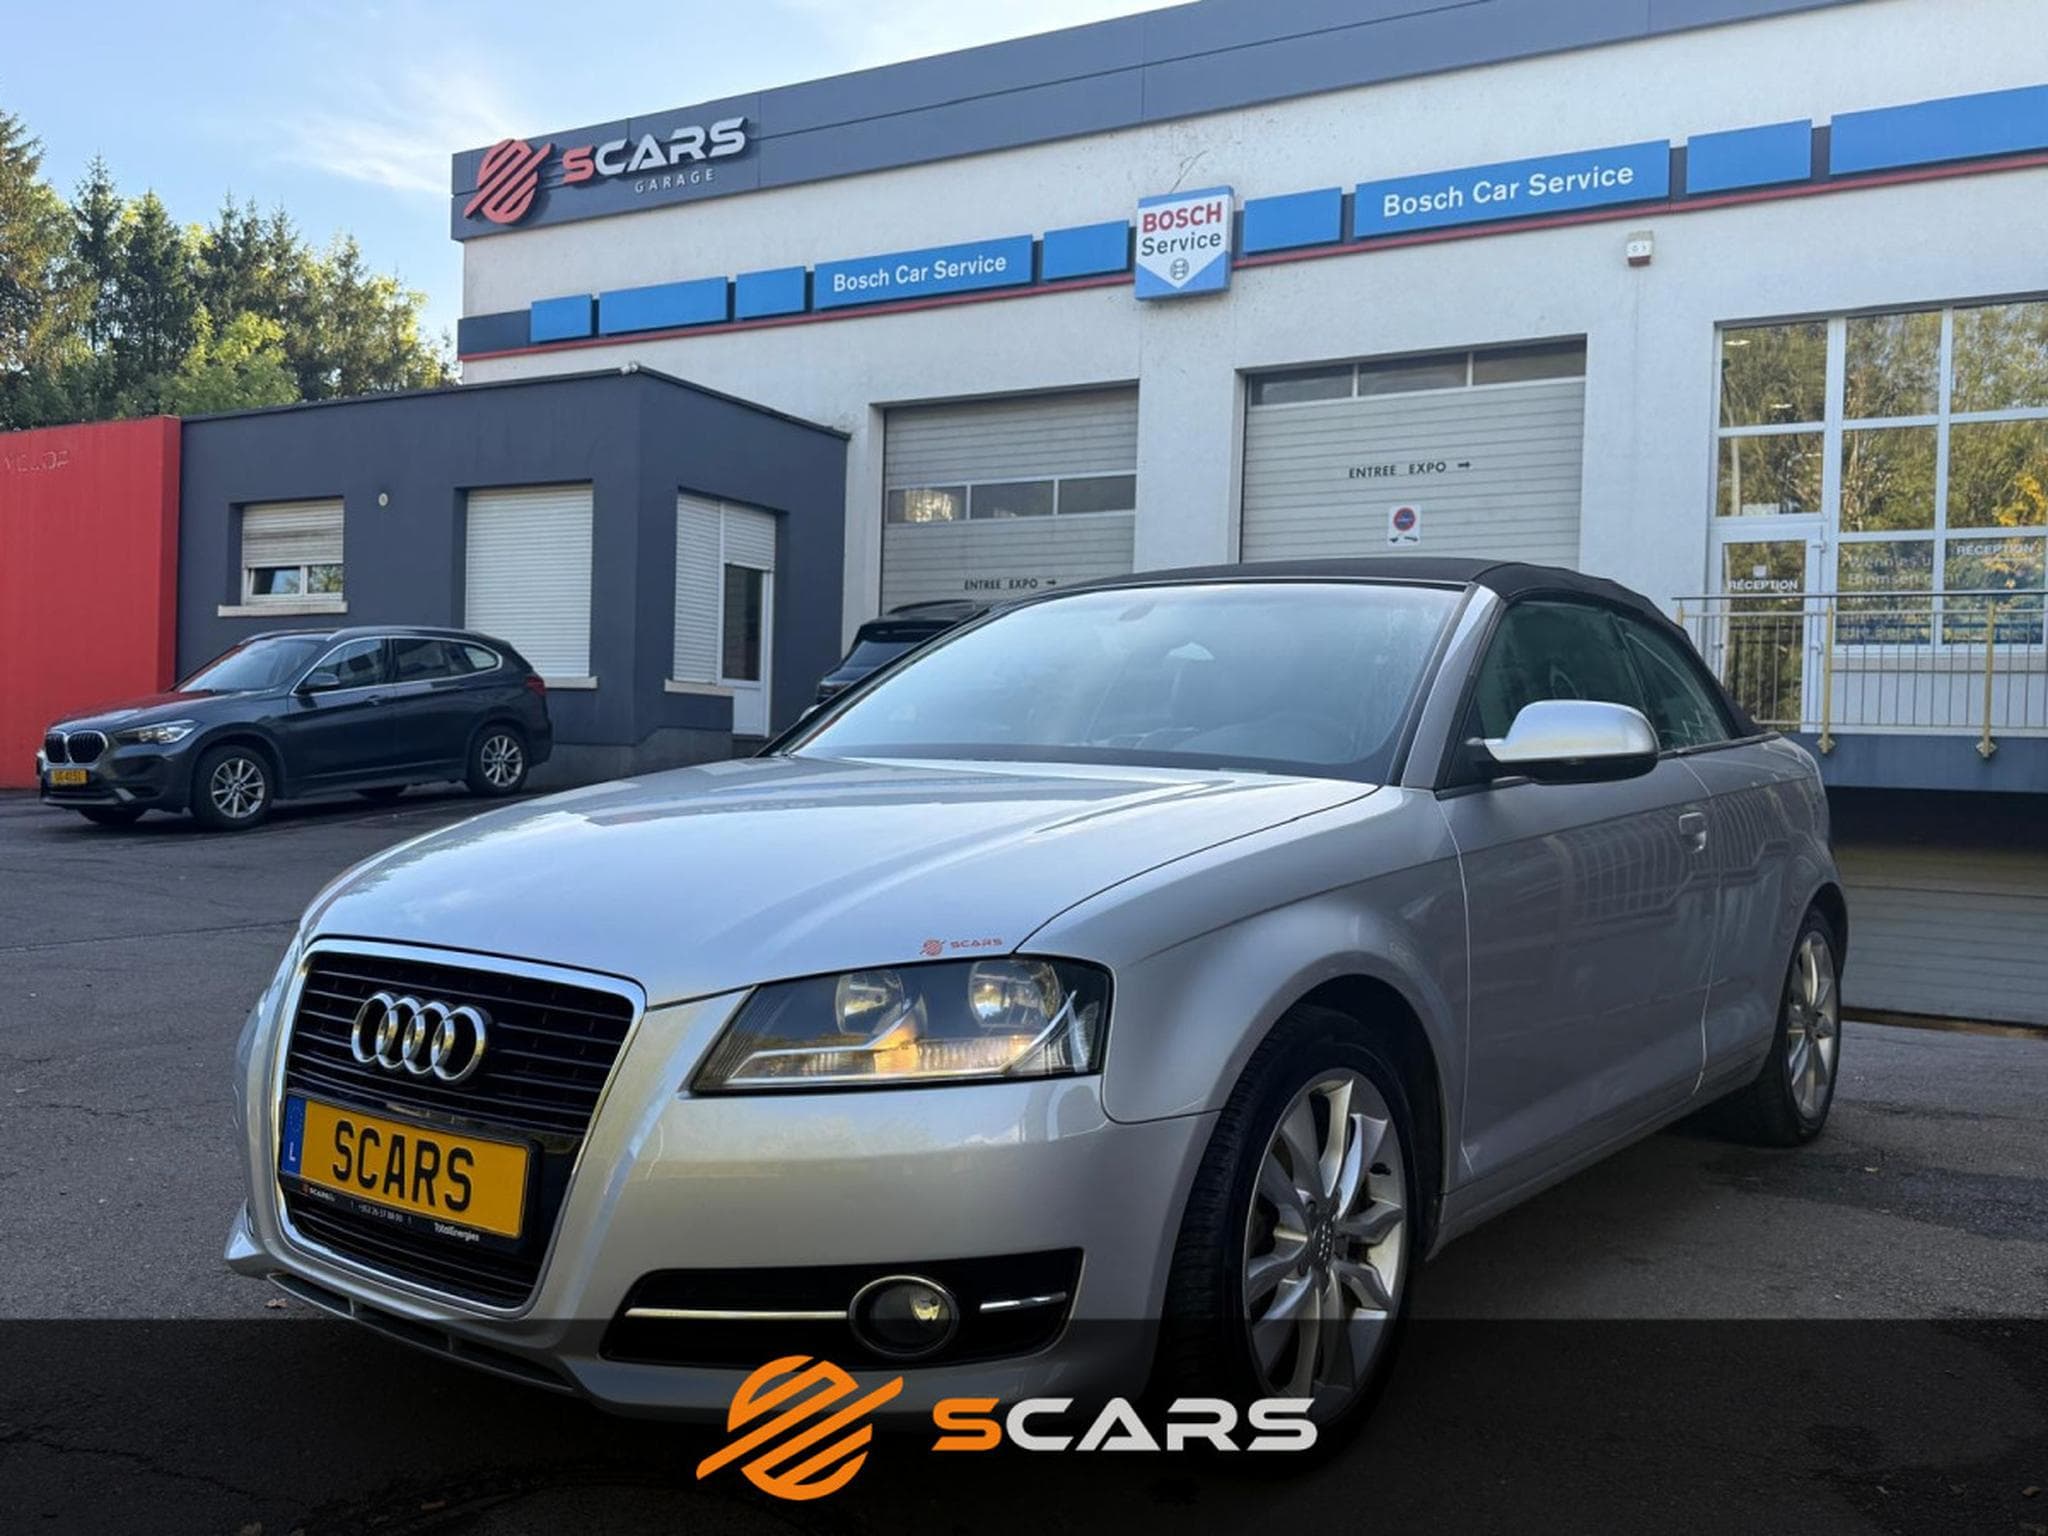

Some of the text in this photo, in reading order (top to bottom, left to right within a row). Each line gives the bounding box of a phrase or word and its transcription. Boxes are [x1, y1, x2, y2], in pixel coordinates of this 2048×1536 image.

[563, 116, 746, 184] SCARS
[634, 168, 715, 194] GARAGE
[1383, 165, 1634, 217] Bosch Car Service
[1142, 201, 1222, 233] BOSCH
[1141, 232, 1222, 256] Service
[833, 255, 1007, 292] Bosch Car Service
[1349, 461, 1447, 479] ENTREE EXPO
[964, 578, 1038, 590] ENTREE EXPO
[288, 1119, 475, 1212] L SCARS
